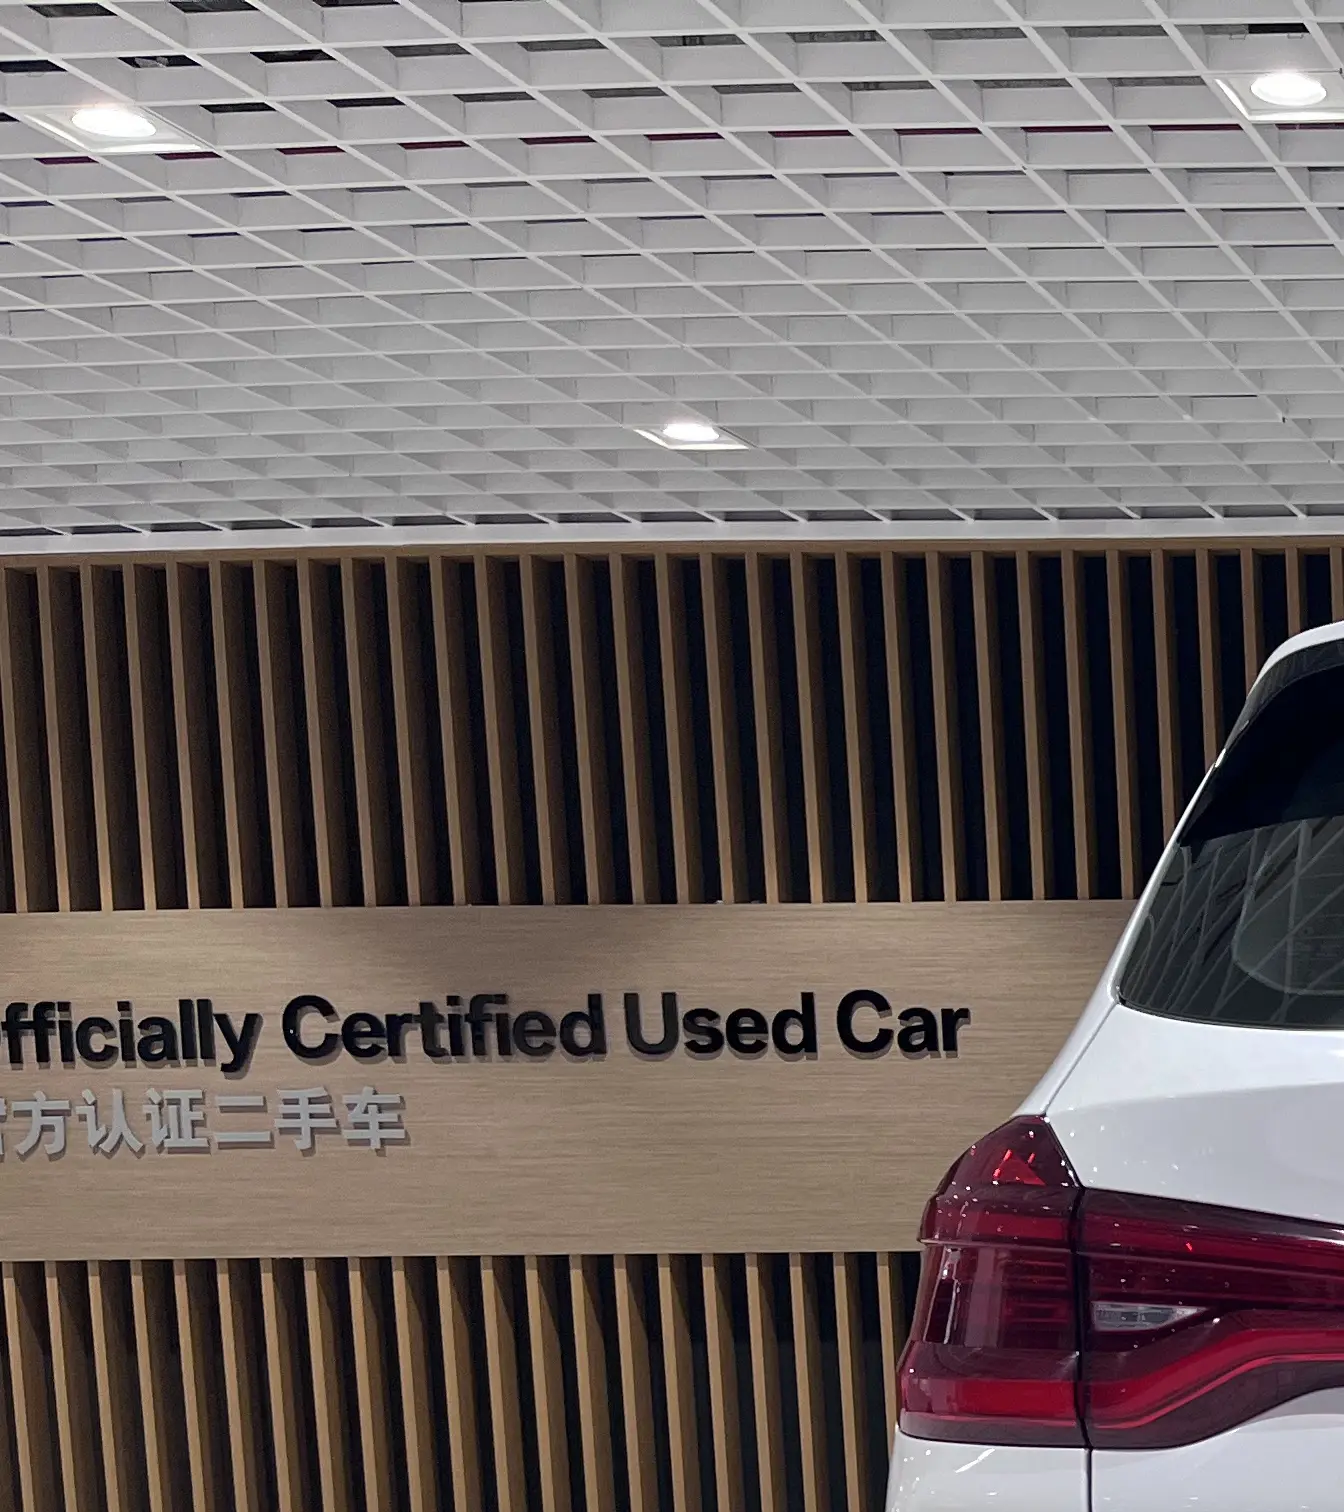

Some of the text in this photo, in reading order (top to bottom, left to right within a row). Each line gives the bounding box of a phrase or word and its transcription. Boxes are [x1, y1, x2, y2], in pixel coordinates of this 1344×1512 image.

[281, 995, 607, 1059] Certified
[623, 992, 818, 1056] Used
[836, 989, 971, 1054] Car
[0, 1086, 406, 1156] 方认证二手车
